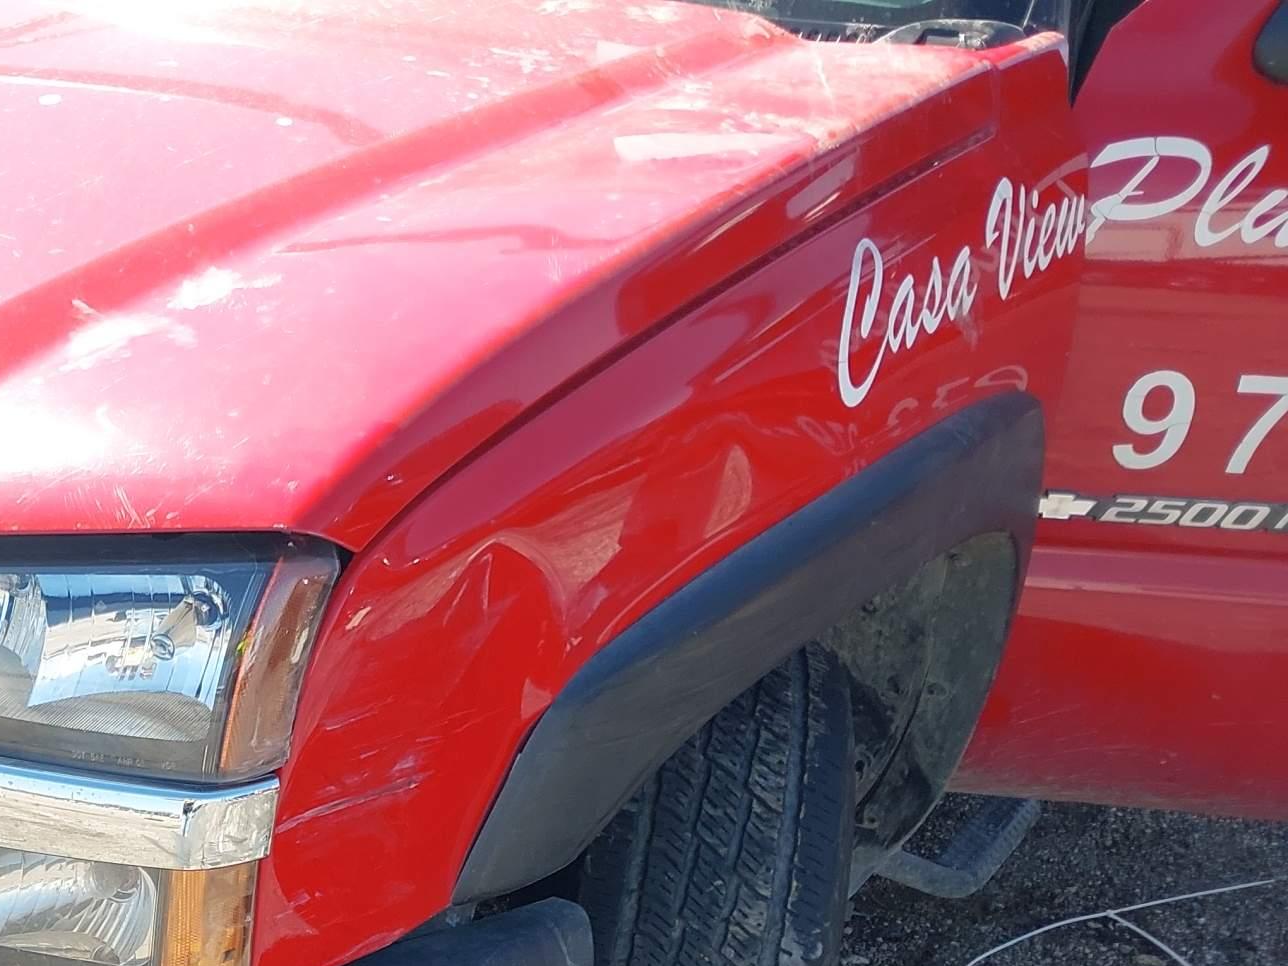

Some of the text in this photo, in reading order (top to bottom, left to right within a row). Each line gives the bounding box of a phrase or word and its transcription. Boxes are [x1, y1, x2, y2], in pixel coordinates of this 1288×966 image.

[838, 238, 978, 408] Casa
[985, 177, 1086, 301] View
[1098, 496, 1271, 530] 2500
